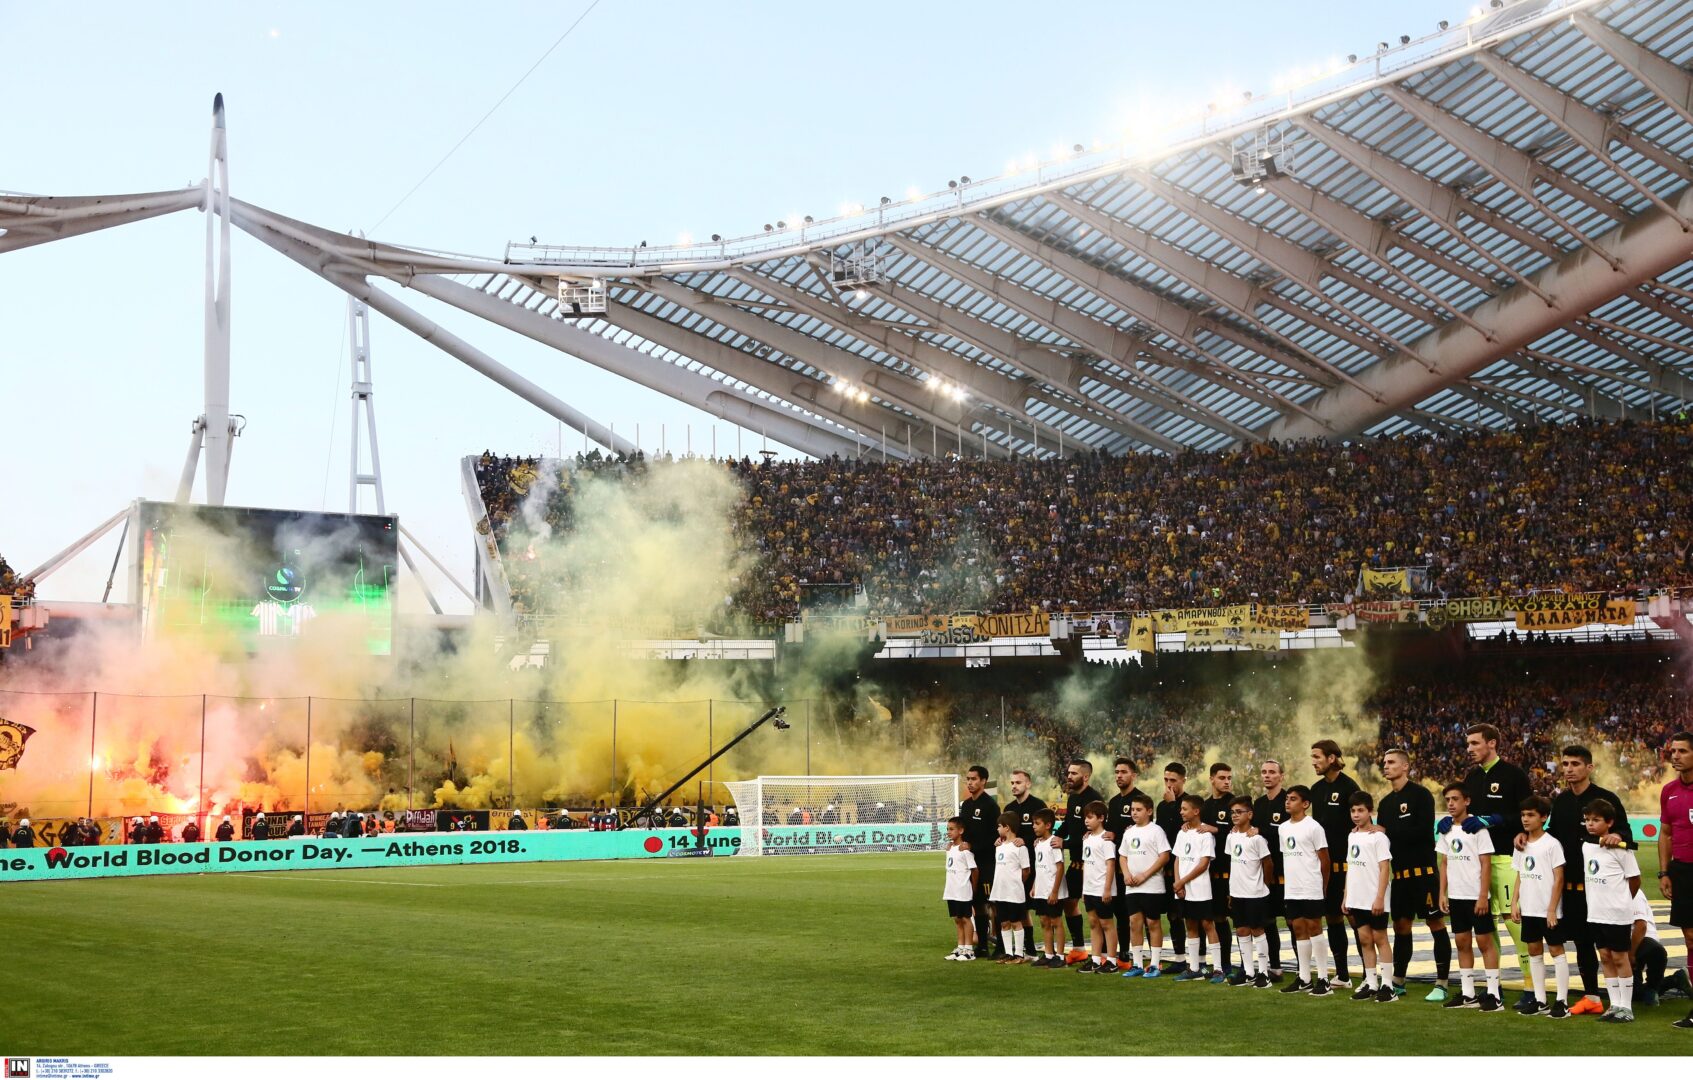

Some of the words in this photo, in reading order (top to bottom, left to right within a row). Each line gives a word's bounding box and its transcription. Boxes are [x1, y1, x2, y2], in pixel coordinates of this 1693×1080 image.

[1503, 600, 1599, 611] ΜΟΣΧΑΤΟ
[1524, 606, 1628, 626] ΚΑΛΑΜΑΤΑ
[668, 835, 690, 848] 14
[872, 830, 924, 844] Donor
[44, 851, 127, 869] World
[137, 847, 209, 865] Blood
[219, 847, 294, 862] Donor
[303, 845, 353, 863] Day.
[471, 840, 526, 855] 2018.
[1504, 884, 1509, 900] 1
